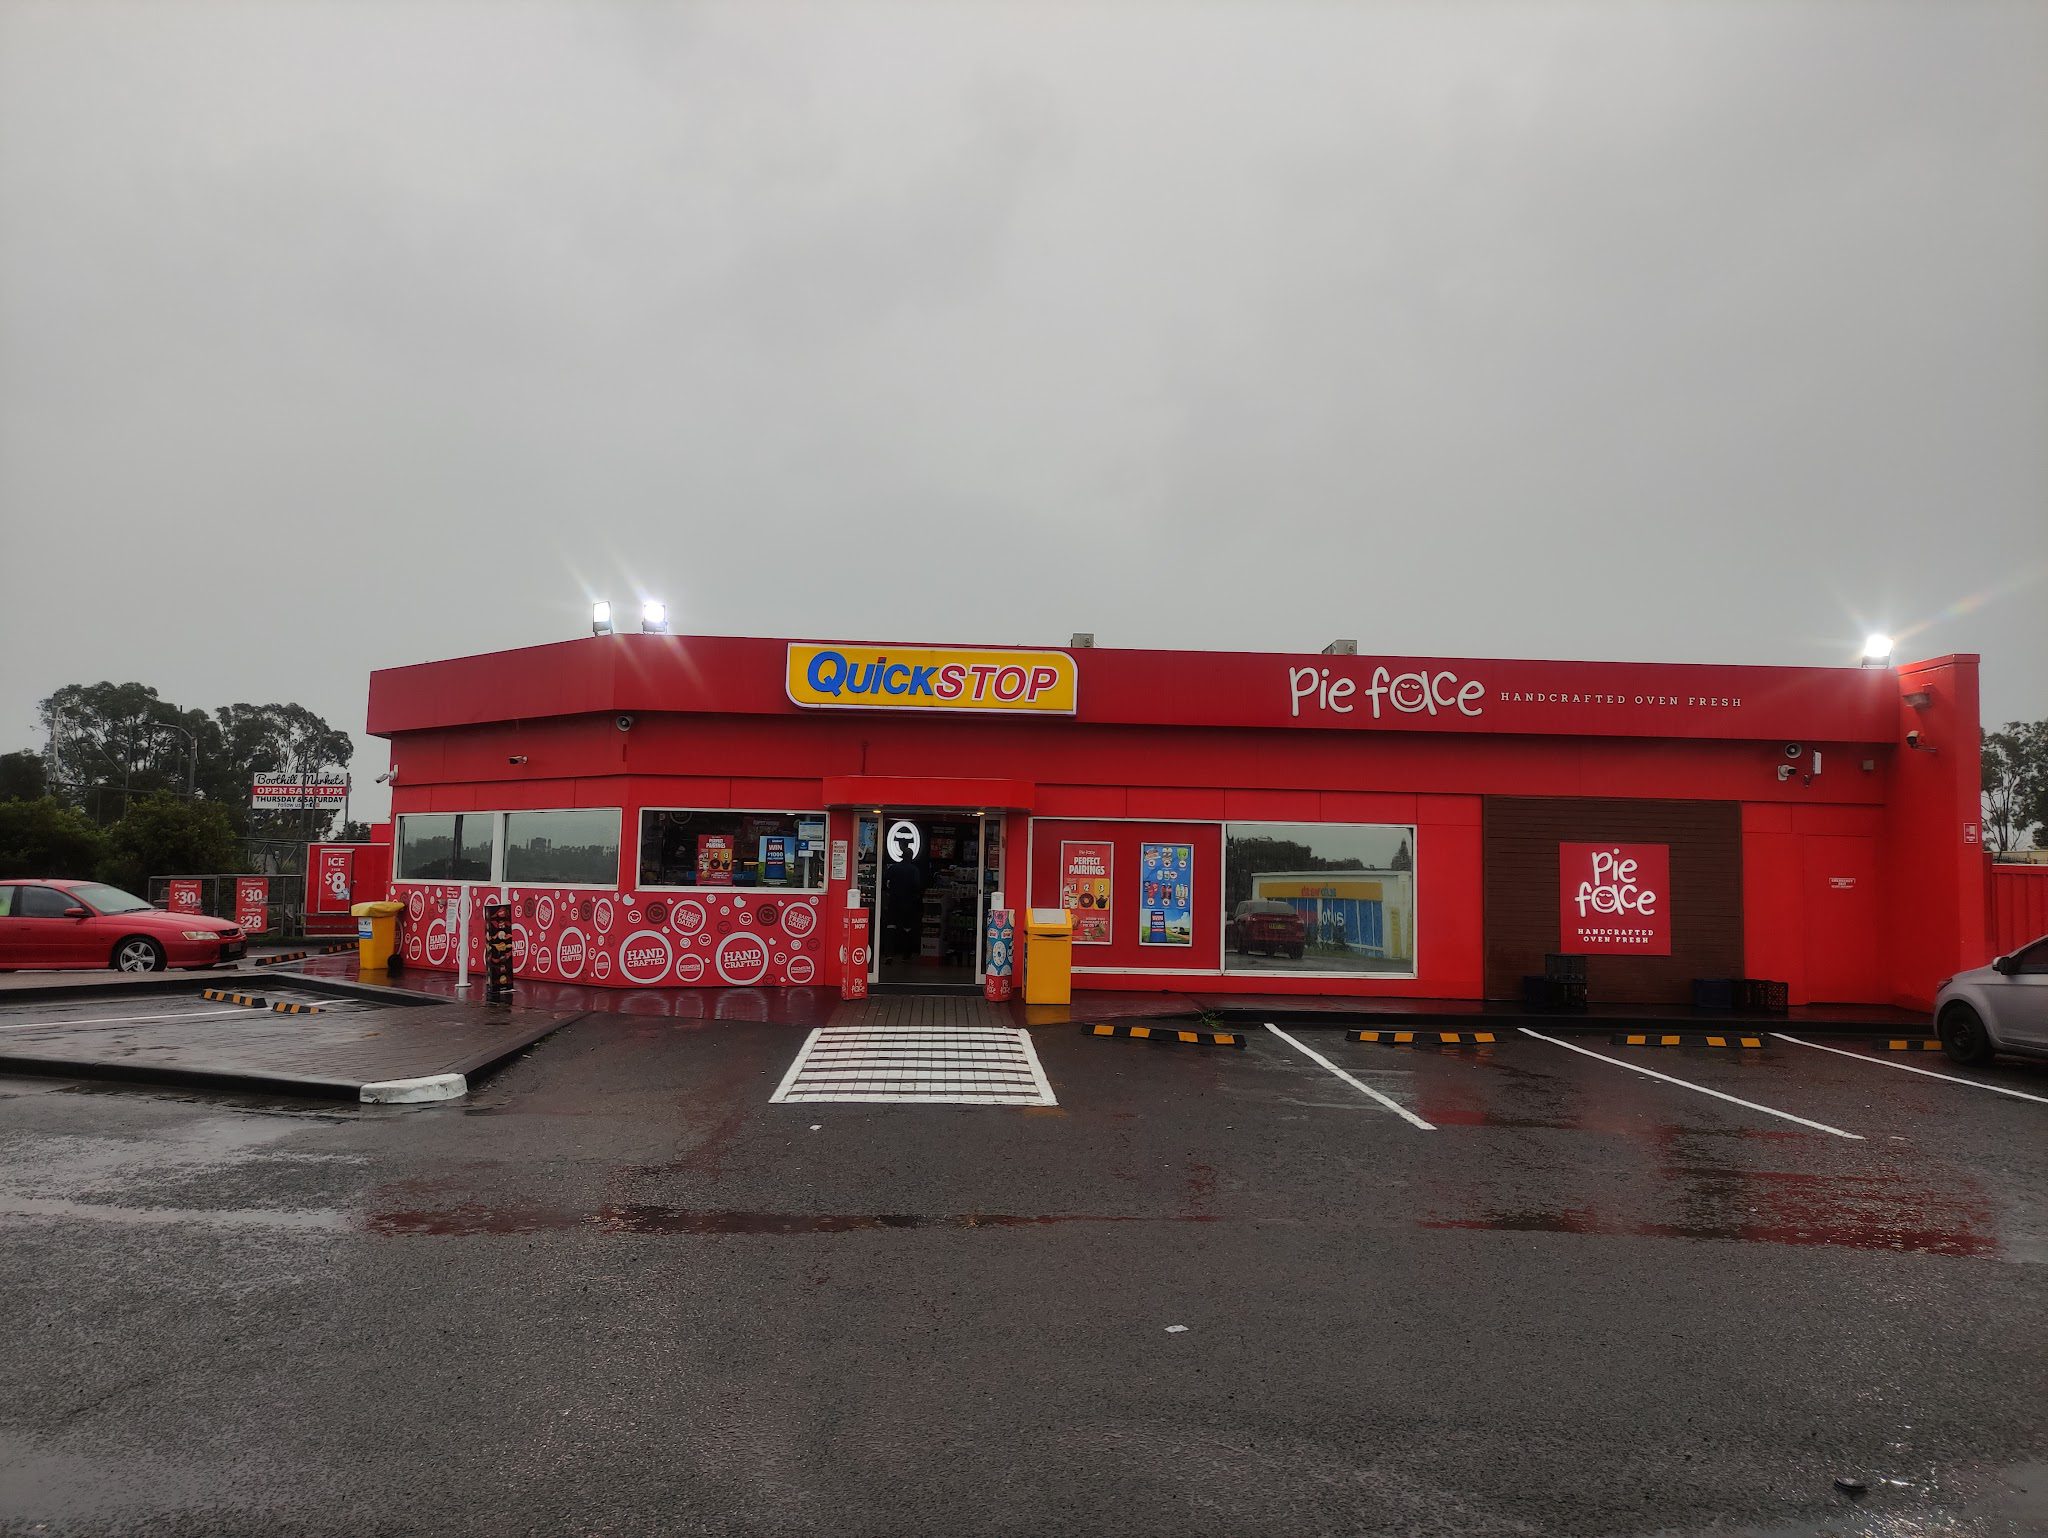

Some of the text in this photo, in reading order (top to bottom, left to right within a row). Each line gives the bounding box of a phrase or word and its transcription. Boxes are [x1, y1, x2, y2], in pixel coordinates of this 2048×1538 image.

[1365, 665, 1486, 719] face
[1500, 691, 1743, 708] HANDCRAFTED OVEN FRESH
[255, 773, 298, 785] Boothill
[256, 787, 287, 795] OPEN
[327, 857, 345, 867] ICE
[1073, 856, 1101, 865] PERFECT
[1068, 865, 1105, 876] PAIRINGS
[325, 872, 346, 893] $8
[174, 891, 196, 905] $30
[241, 889, 263, 902] $30
[1574, 881, 1657, 918] face
[240, 915, 262, 928] $28
[677, 918, 696, 928] DAILY
[1577, 928, 1655, 936] HANDCRAFTED
[430, 934, 446, 944] HAND
[1615, 936, 1649, 944] FRESH
[561, 944, 582, 955] HAND
[626, 947, 665, 961] HAND
[561, 954, 582, 962] CRAFTED
[723, 949, 762, 963] HAND
[627, 958, 666, 968] CRAFTED
[724, 959, 762, 969] CRAFTED
